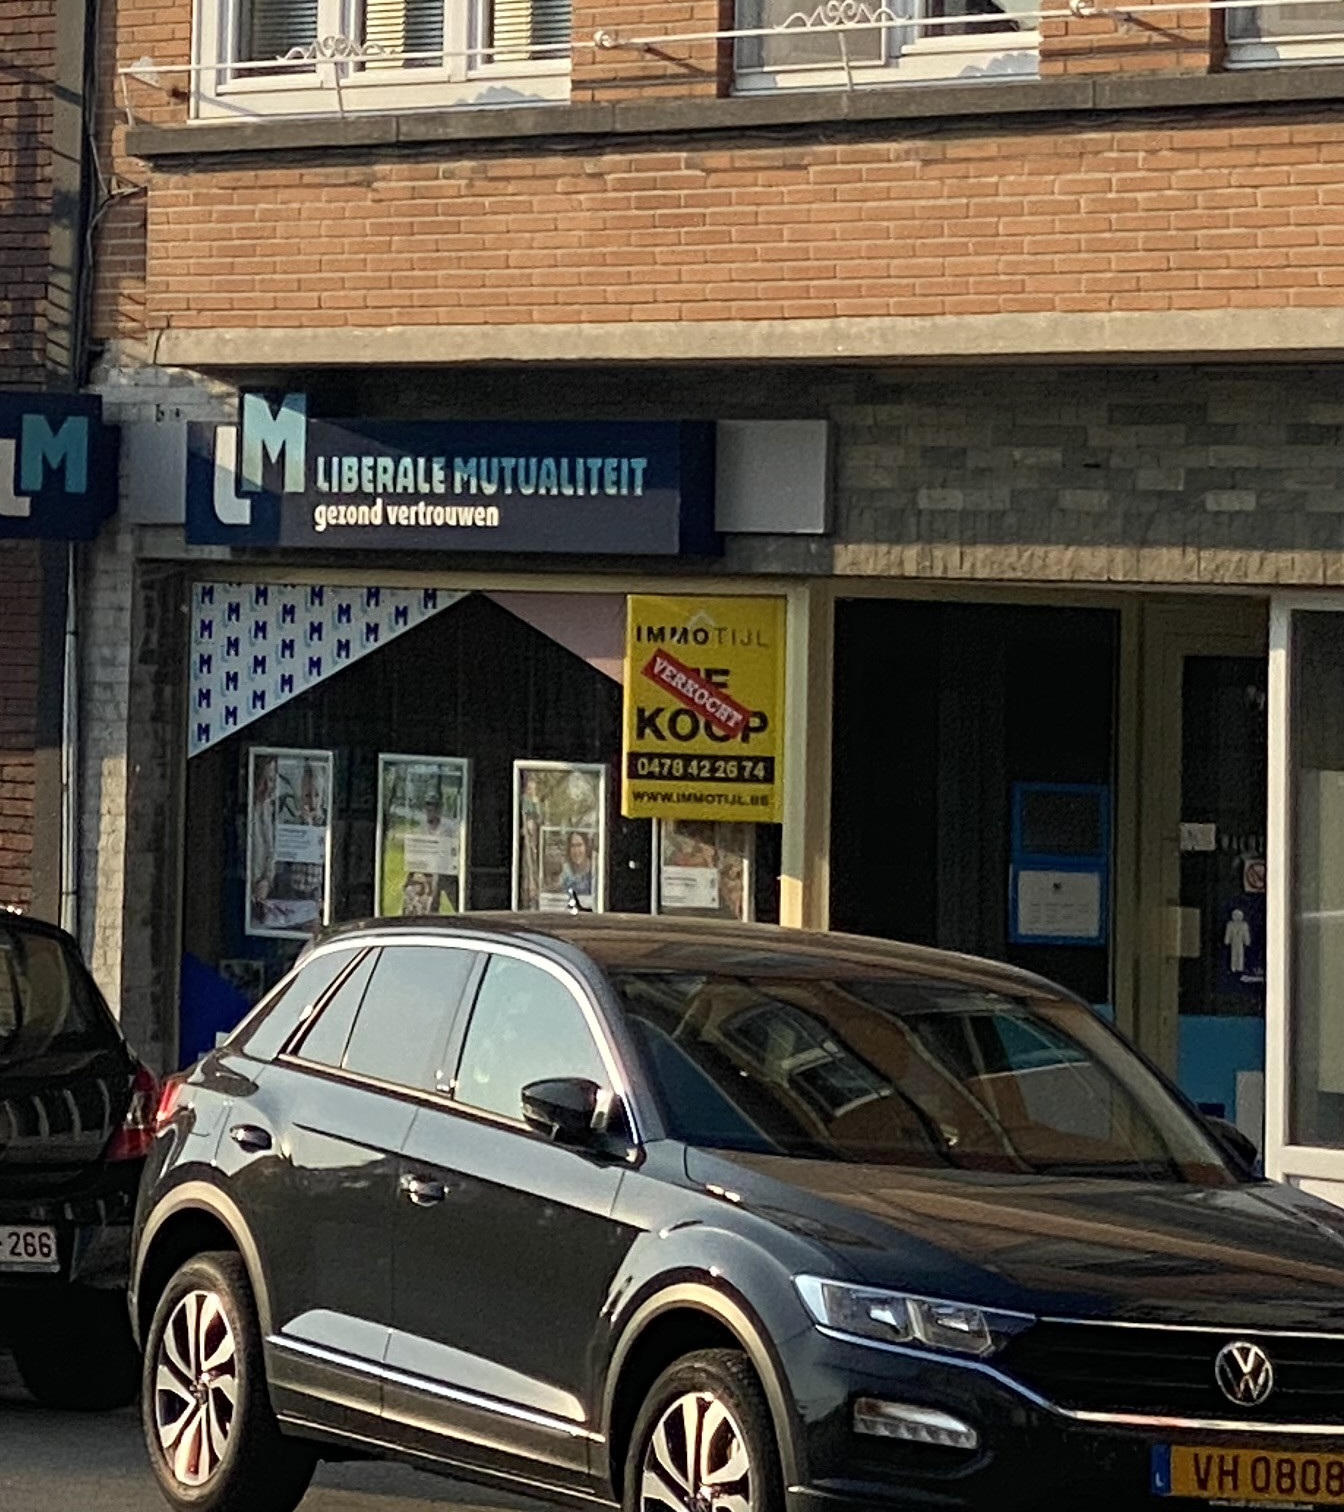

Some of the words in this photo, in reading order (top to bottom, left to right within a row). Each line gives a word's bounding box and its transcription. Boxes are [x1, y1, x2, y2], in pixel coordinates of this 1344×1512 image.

[316, 456, 446, 494] LIBERALE
[453, 456, 648, 497] MUTUALITEIT
[314, 497, 384, 532] gezond
[387, 501, 500, 527] vertrouwen
[653, 656, 743, 727] VERKOCHT
[688, 759, 711, 778] 42
[741, 760, 765, 781] 74
